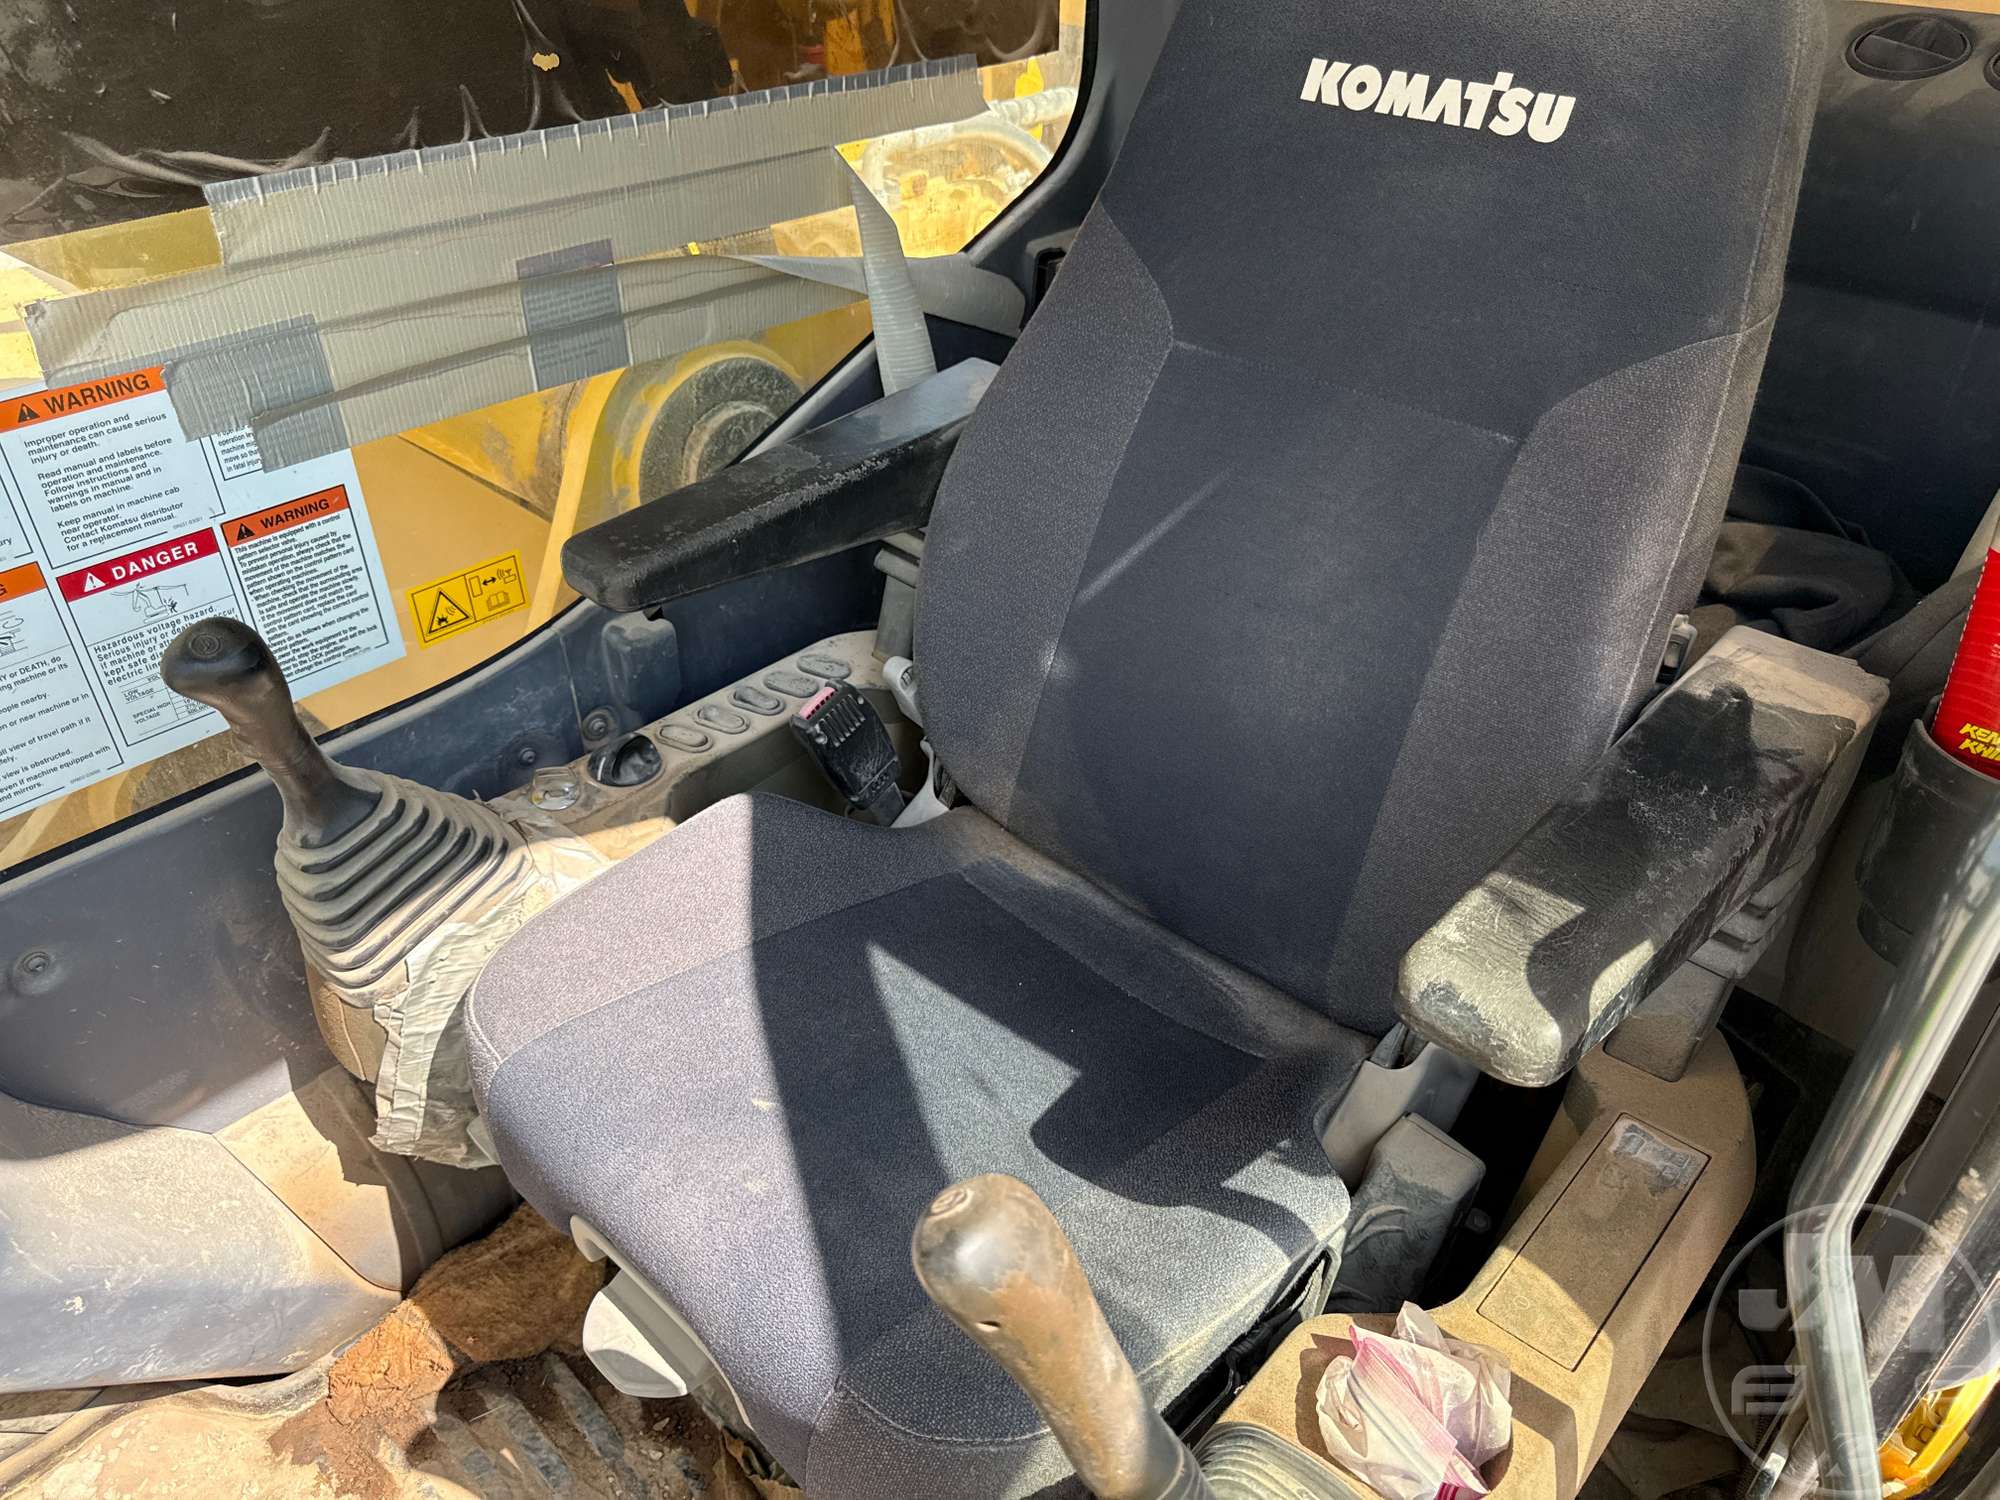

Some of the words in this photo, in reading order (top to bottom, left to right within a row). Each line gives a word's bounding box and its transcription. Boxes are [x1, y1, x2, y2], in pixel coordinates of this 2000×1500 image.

[1300, 57, 1577, 143] KOMATSU
[42, 372, 150, 416] WARNING
[23, 430, 67, 448] Improper
[67, 418, 112, 436] operation
[112, 413, 130, 424] and
[27, 434, 87, 456] maintenance
[87, 430, 104, 439] can
[105, 422, 133, 434] cause
[133, 411, 167, 426] serious
[30, 451, 58, 465] injury
[59, 448, 69, 456] or
[70, 439, 99, 453] death.
[37, 468, 62, 480] Read
[62, 458, 97, 473] manual
[97, 452, 115, 463] and
[116, 444, 143, 457] labels
[143, 436, 172, 450] before
[40, 470, 85, 490] operation
[85, 465, 103, 475] and
[104, 448, 162, 470] maintenance.
[43, 482, 75, 497] Follow
[76, 466, 129, 488] instructions
[130, 461, 147, 471] and
[47, 487, 90, 506] warnings
[90, 484, 100, 492] in
[100, 473, 134, 489] manual
[134, 468, 151, 479] and
[152, 465, 162, 473] in
[50, 499, 78, 513] labels
[79, 496, 92, 504] on
[56, 515, 81, 529] Keep
[81, 505, 115, 521] manual
[115, 502, 125, 510] in
[126, 490, 163, 508] machine
[163, 485, 180, 496] cab
[63, 527, 98, 545] Contact
[99, 515, 139, 533] Komatsu
[139, 500, 184, 521] distributor
[259, 497, 329, 530] WARNING
[60, 525, 80, 536] near
[82, 512, 122, 531] operator.
[66, 542, 80, 552] for
[89, 522, 143, 547] replacement
[110, 540, 199, 580] DANGER
[93, 630, 144, 653] Hazardous
[145, 617, 182, 636] voltage
[182, 604, 217, 621] hazard.
[96, 644, 131, 661] Serious
[131, 635, 157, 650] injury
[159, 631, 169, 639] or
[8, 670, 17, 678] or
[49, 654, 61, 664] do
[13, 668, 47, 688] machine
[47, 666, 57, 674] or
[57, 661, 68, 671] its
[99, 661, 108, 669] if
[108, 647, 146, 666] machine
[146, 644, 157, 652] or
[103, 664, 125, 678] kept
[126, 656, 147, 669] safe
[106, 666, 144, 685] electric
[8, 719, 17, 727] or
[19, 711, 36, 724] near
[37, 698, 70, 717] machine
[71, 696, 80, 704] or
[80, 691, 89, 700] in
[8, 740, 26, 753] view
[27, 736, 35, 745] of
[36, 728, 59, 742] travel
[59, 721, 78, 733] path
[77, 718, 84, 726] if
[84, 715, 91, 723] it
[1, 767, 20, 780] view
[21, 764, 29, 773] is
[30, 747, 72, 769] obstructed.
[18, 777, 24, 786] if
[25, 765, 58, 783] machine
[58, 750, 94, 770] equipped
[93, 744, 111, 755] with
